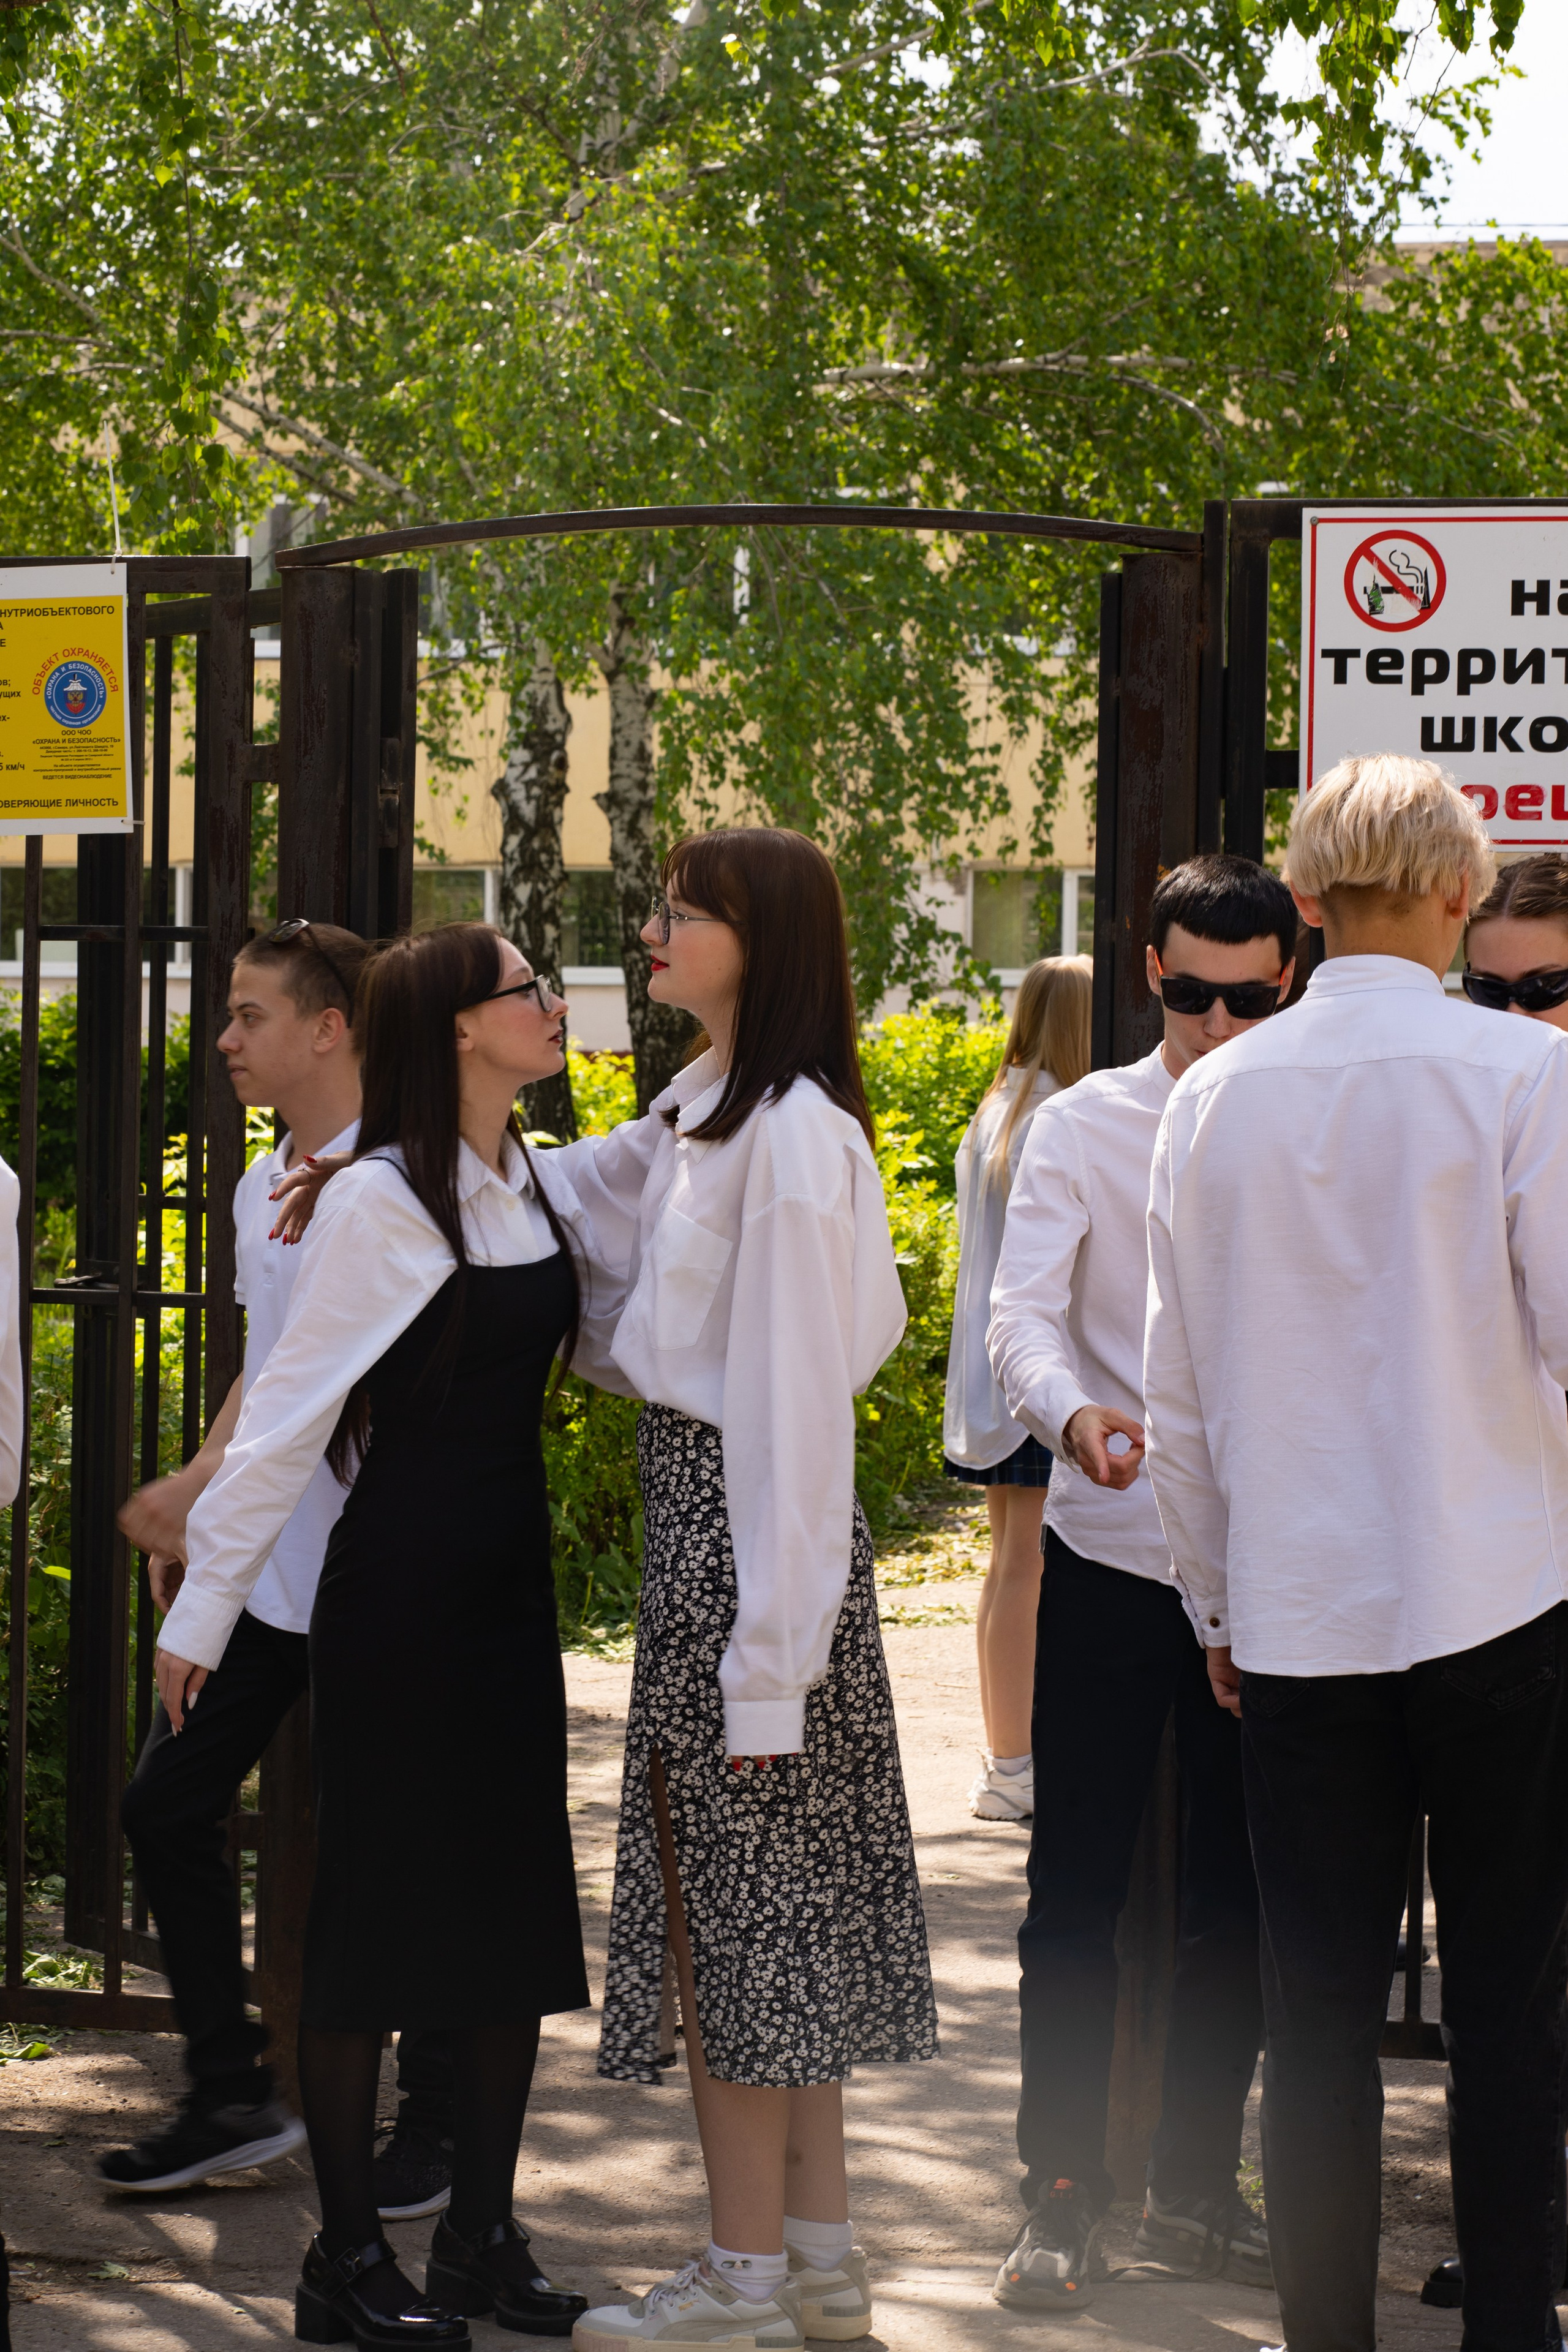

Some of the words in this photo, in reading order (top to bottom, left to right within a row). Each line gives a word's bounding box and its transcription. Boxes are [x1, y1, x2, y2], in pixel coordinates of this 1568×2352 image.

[0, 606, 115, 617] НУТРИОБЪЕКТОВОГО
[1511, 579, 1568, 616] н
[32, 652, 59, 695] ОБЪЕКТ
[62, 647, 119, 693] ОХРАНЯЕТСЯ
[46, 672, 60, 699] «ОХРАНА
[68, 663, 105, 698] БЕЗОПАСНОСТЬ»
[1421, 716, 1568, 753] шко
[6, 762, 25, 771] км/ч
[65, 798, 118, 807] ЛИЧНОСТЬ
